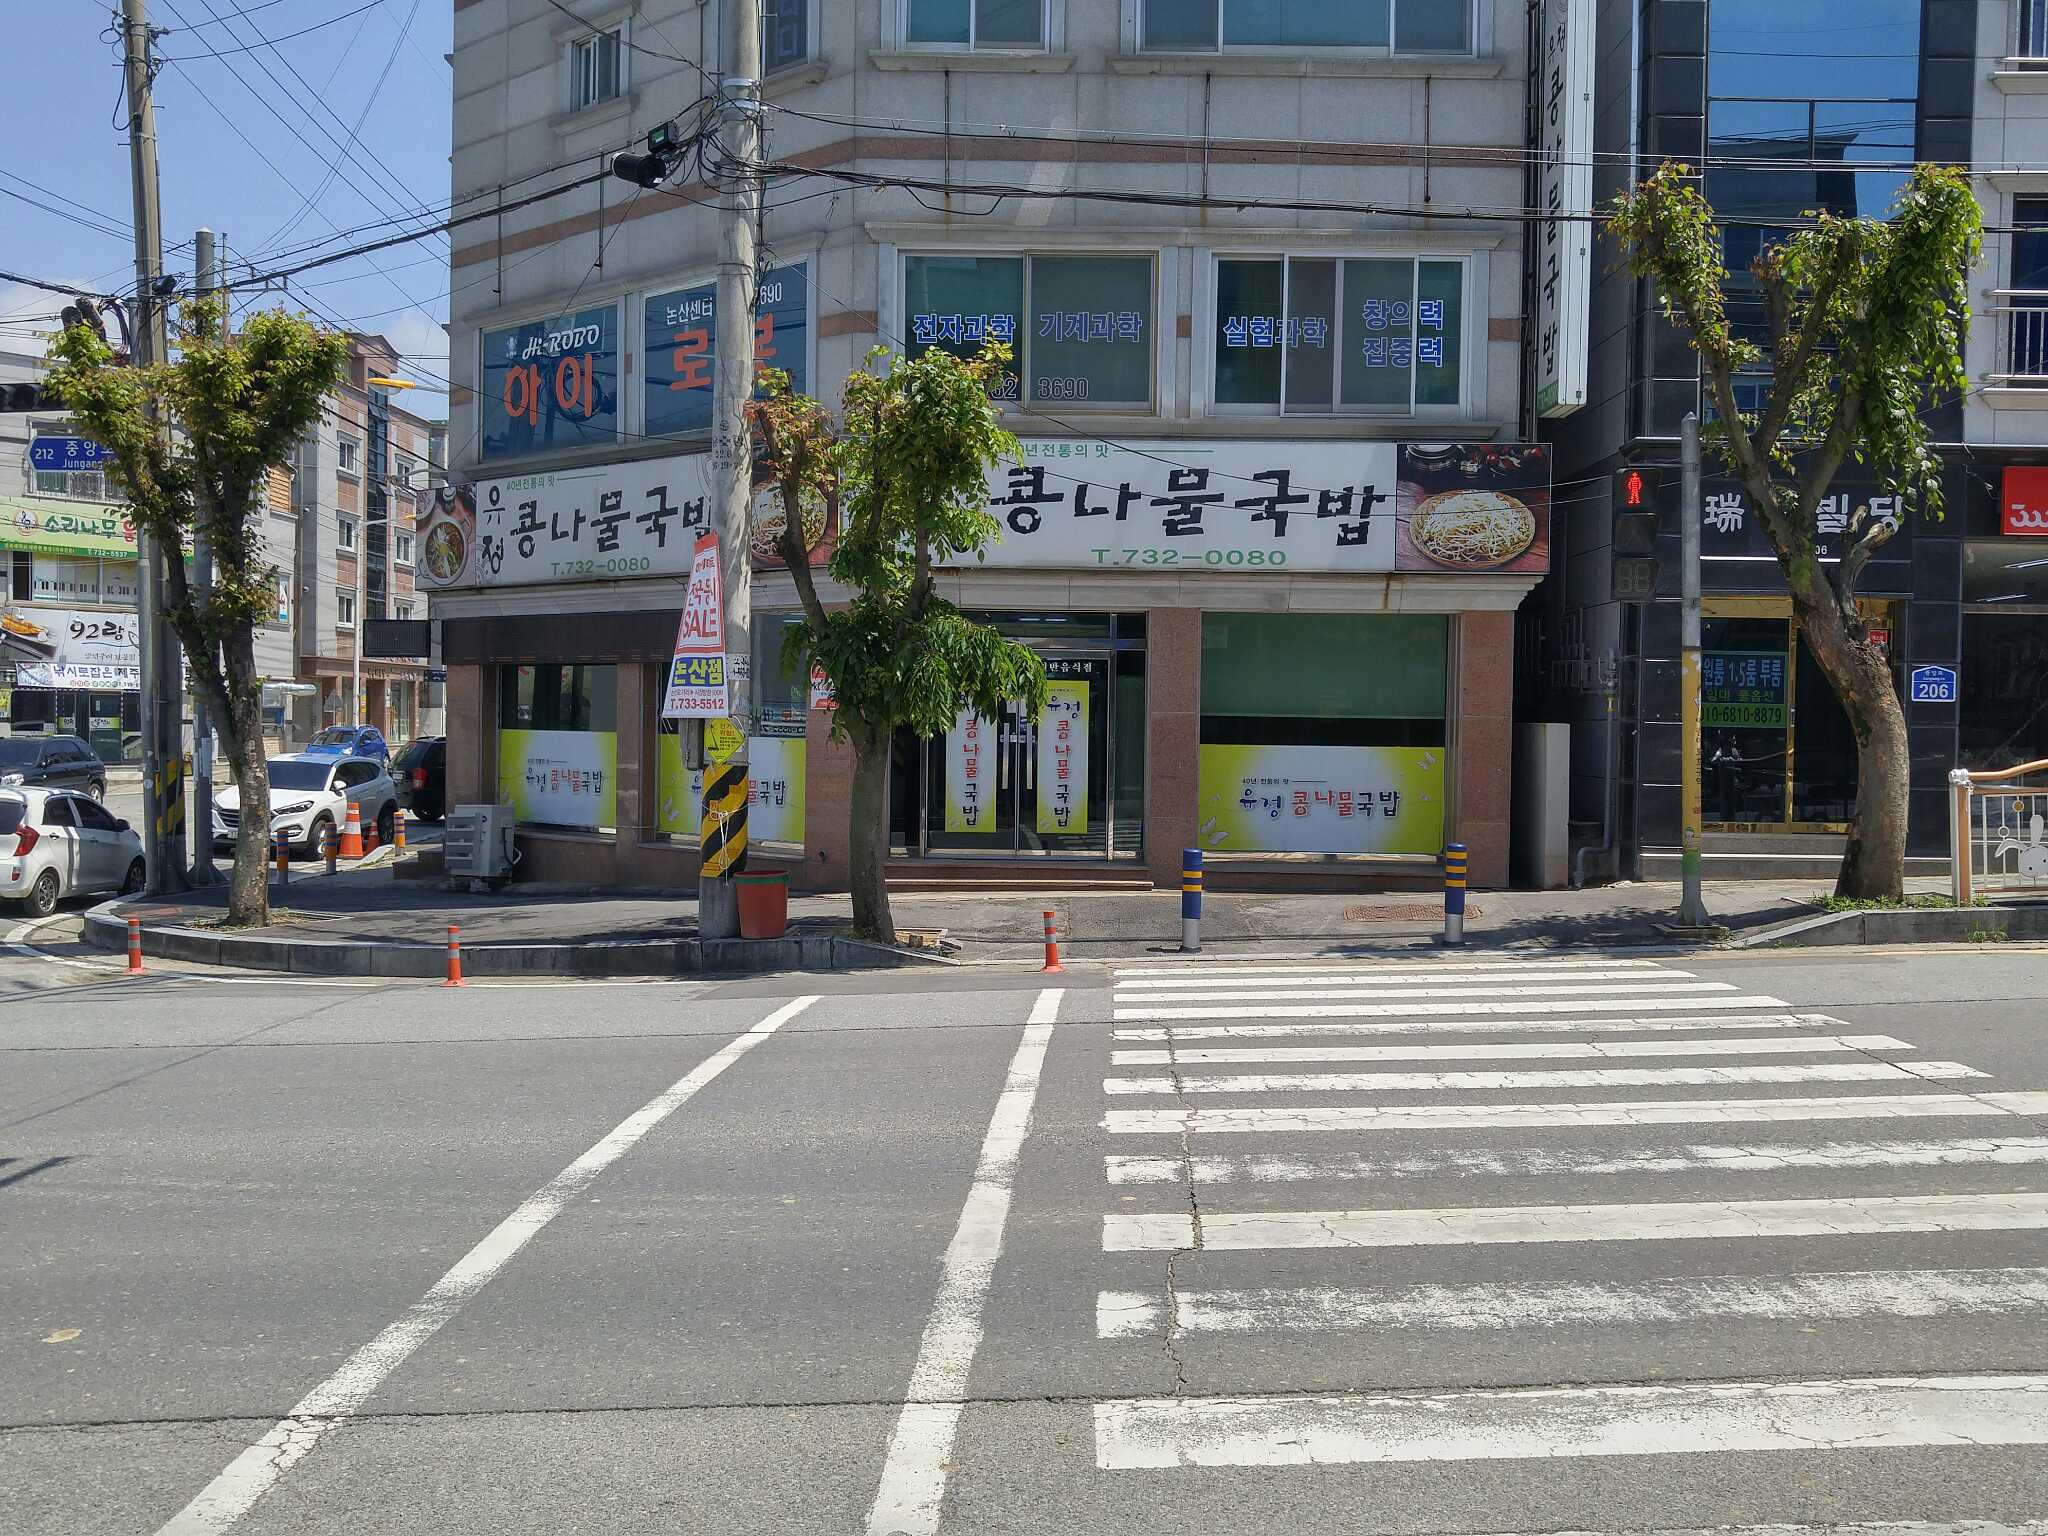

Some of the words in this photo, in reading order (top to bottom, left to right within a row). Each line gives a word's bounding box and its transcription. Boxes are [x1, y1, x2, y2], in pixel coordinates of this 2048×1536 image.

[666, 297, 713, 325] 논산센터
[1362, 299, 1444, 331] 창의력
[912, 313, 1017, 345] 전자과학
[1038, 311, 1143, 343] 기계과학
[1223, 316, 1328, 349] 실험과학
[522, 324, 600, 360] Hi-ROBO
[1362, 337, 1444, 368] 집중력
[1038, 377, 1089, 399] 3690
[35, 449, 54, 459] 212
[65, 440, 115, 457] 중앙
[1095, 443, 1109, 457] 맛
[990, 465, 1386, 547] 콩나물국밥
[551, 556, 650, 576] T.732-0080
[1091, 549, 1287, 566] T.732-0080
[69, 620, 125, 641] 92랑
[682, 608, 717, 640] SALE
[674, 657, 723, 685] 논산점
[1044, 662, 1092, 673] 반음식점
[671, 698, 724, 710] T.733-5512
[1919, 684, 1949, 698] 206
[961, 719, 980, 826] 콩나물국밥
[1054, 720, 1071, 828] 콩나물국밥
[1240, 789, 1282, 818] 유정
[1291, 790, 1400, 817] 콩나물국밥
